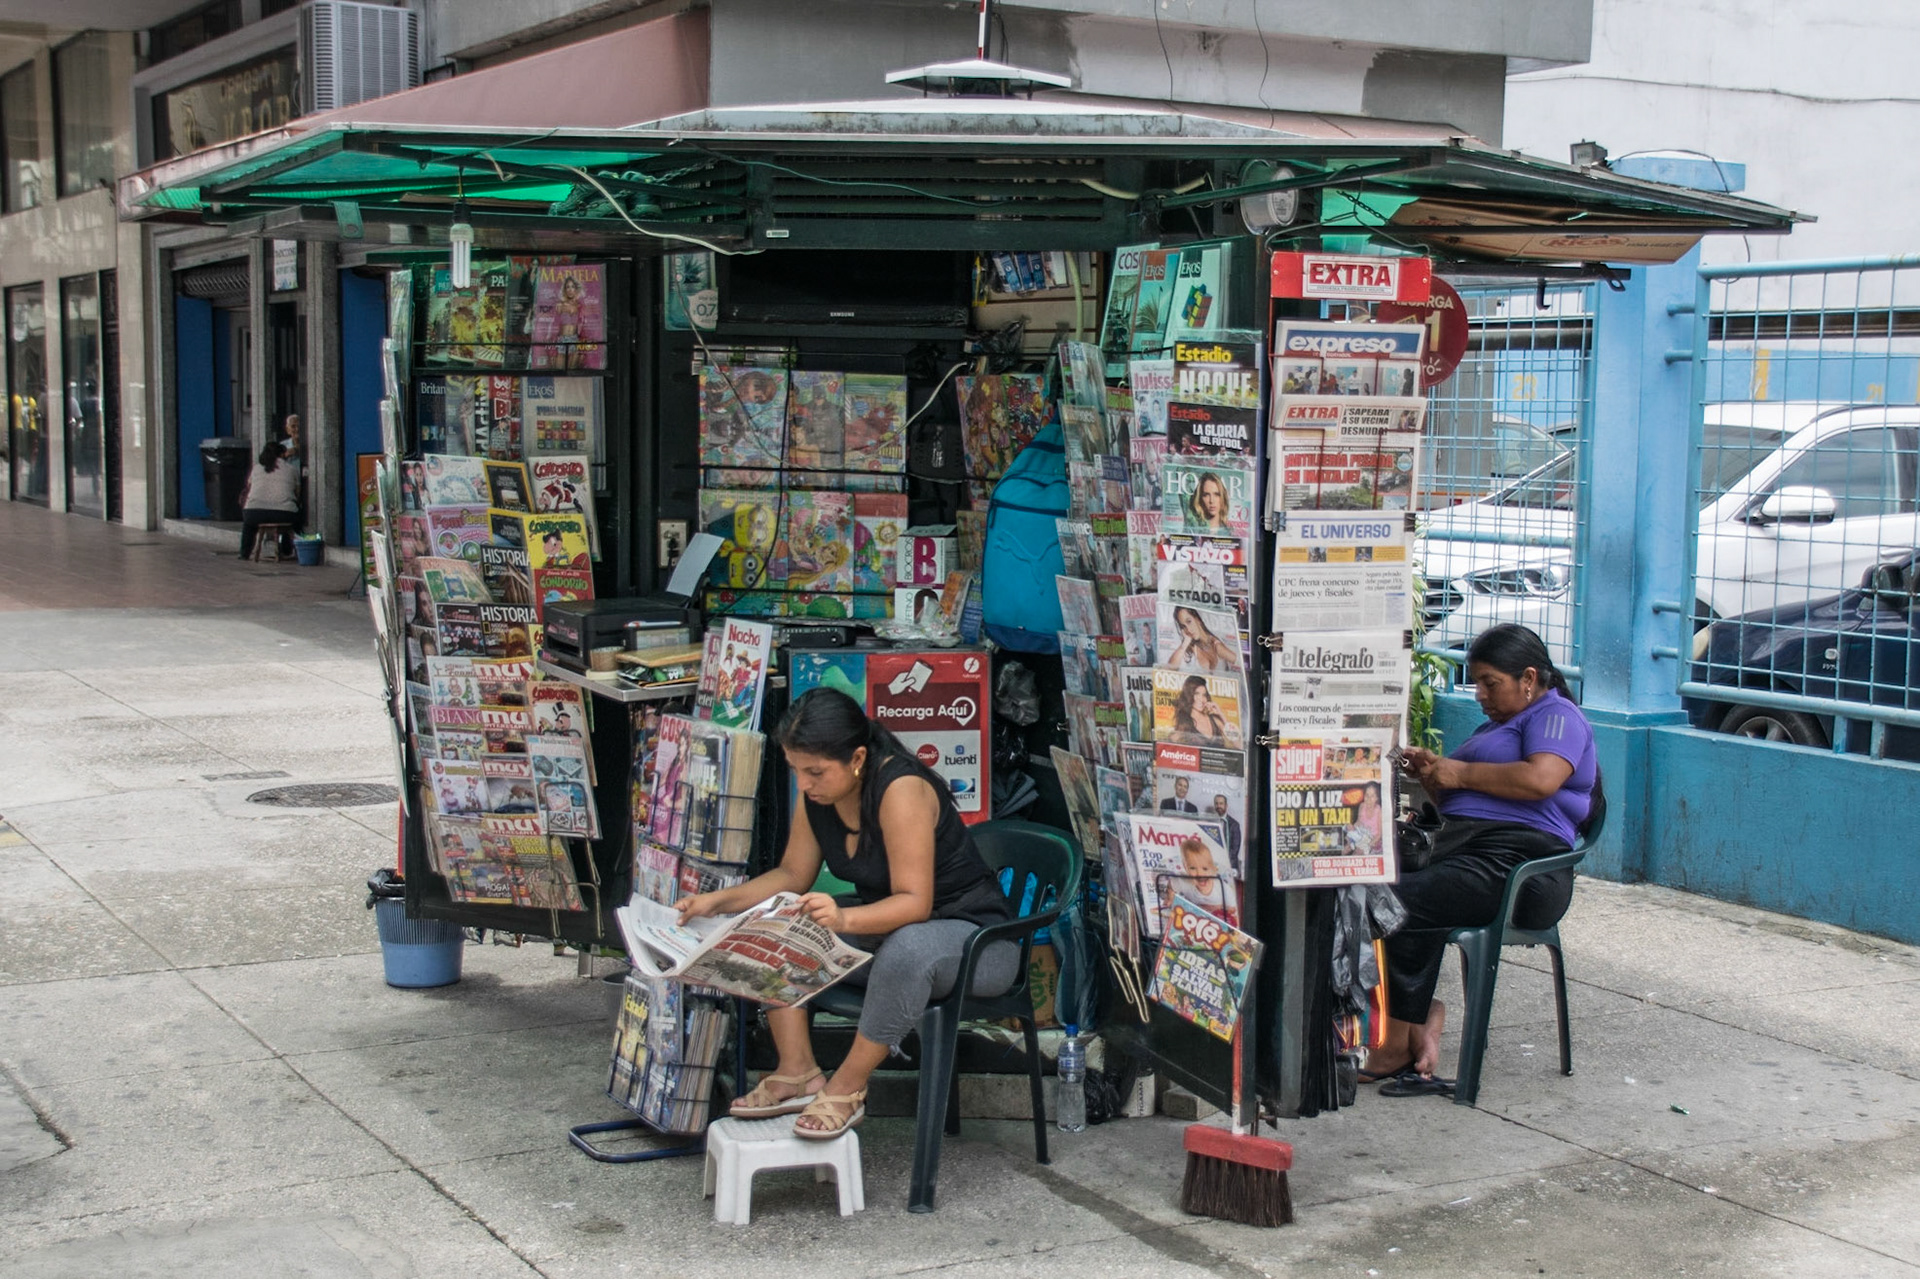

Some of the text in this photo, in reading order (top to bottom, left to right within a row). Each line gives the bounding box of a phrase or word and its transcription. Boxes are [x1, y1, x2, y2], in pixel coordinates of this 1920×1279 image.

[1309, 263, 1391, 286] EXTRA
[1425, 310, 1441, 352] 1
[1176, 344, 1232, 363] Estadio
[1288, 336, 1397, 357] expreso
[420, 382, 446, 395] Britan
[528, 385, 554, 397] EKOS
[1170, 406, 1211, 421] Estadio
[1287, 407, 1339, 419] EXTRA
[1361, 417, 1389, 425] VECINA
[1193, 424, 1247, 440] LA GLORIA
[1200, 435, 1212, 446] DEL
[1166, 470, 1244, 500] HOR
[1301, 524, 1391, 539] EL UNIVERSO
[914, 537, 937, 584] B
[1278, 577, 1359, 587] CPC frena concurso
[1168, 590, 1222, 604] ESTADO
[1278, 587, 1354, 599] de jueces y fiscales
[480, 606, 539, 623] HISTORIA
[728, 624, 761, 646] Nacho
[1154, 670, 1237, 698] COSMLITAN
[877, 702, 968, 721] Recarga Aquí
[1278, 702, 1292, 712] Los
[1293, 703, 1329, 713] concursos
[1330, 702, 1342, 713] de
[1277, 715, 1336, 726] jueces y fiscales
[944, 754, 977, 766] tuenti
[1161, 749, 1196, 762] América
[484, 761, 532, 777] muy
[1304, 791, 1316, 807] A
[1320, 790, 1343, 806] LUZ
[1277, 808, 1351, 826] EN UN TAXI
[1141, 849, 1162, 862] Top
